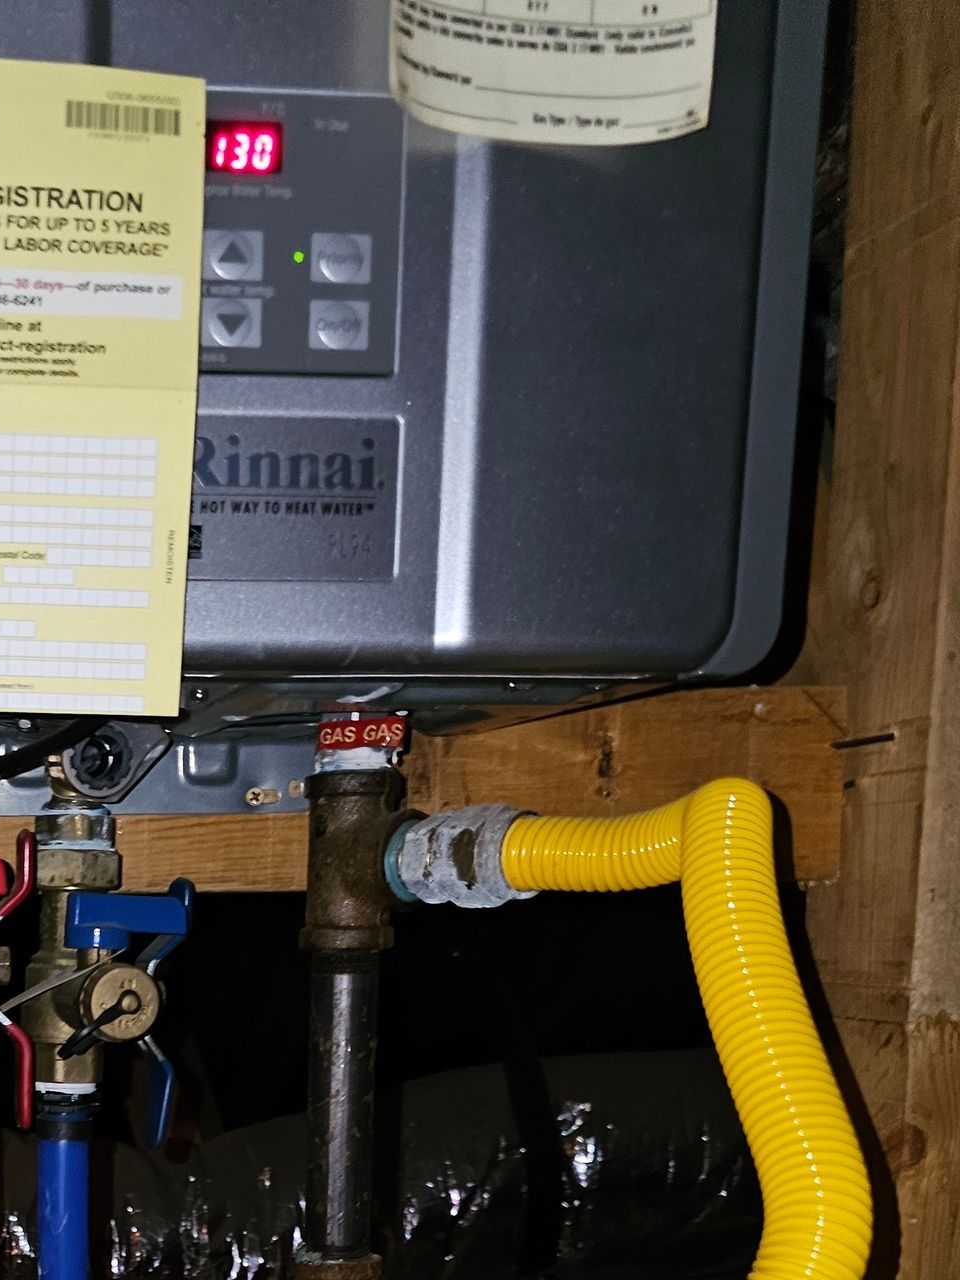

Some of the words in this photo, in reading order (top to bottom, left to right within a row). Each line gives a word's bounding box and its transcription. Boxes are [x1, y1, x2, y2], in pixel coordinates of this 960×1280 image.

[213, 132, 275, 171] 130
[6, 215, 41, 231] FOR
[46, 217, 69, 232] UP
[73, 217, 97, 233] TO
[100, 219, 111, 234] 5
[114, 221, 171, 237] YEARS
[4, 237, 62, 253] LABOR
[94, 283, 154, 294] purchase
[157, 286, 171, 295] or
[27, 321, 42, 332] at
[200, 501, 226, 515] HOT
[232, 502, 259, 515] WAY
[264, 502, 280, 516] TO
[285, 503, 316, 516] HEAT
[320, 727, 357, 744] GAS
[362, 723, 404, 742] GAS
